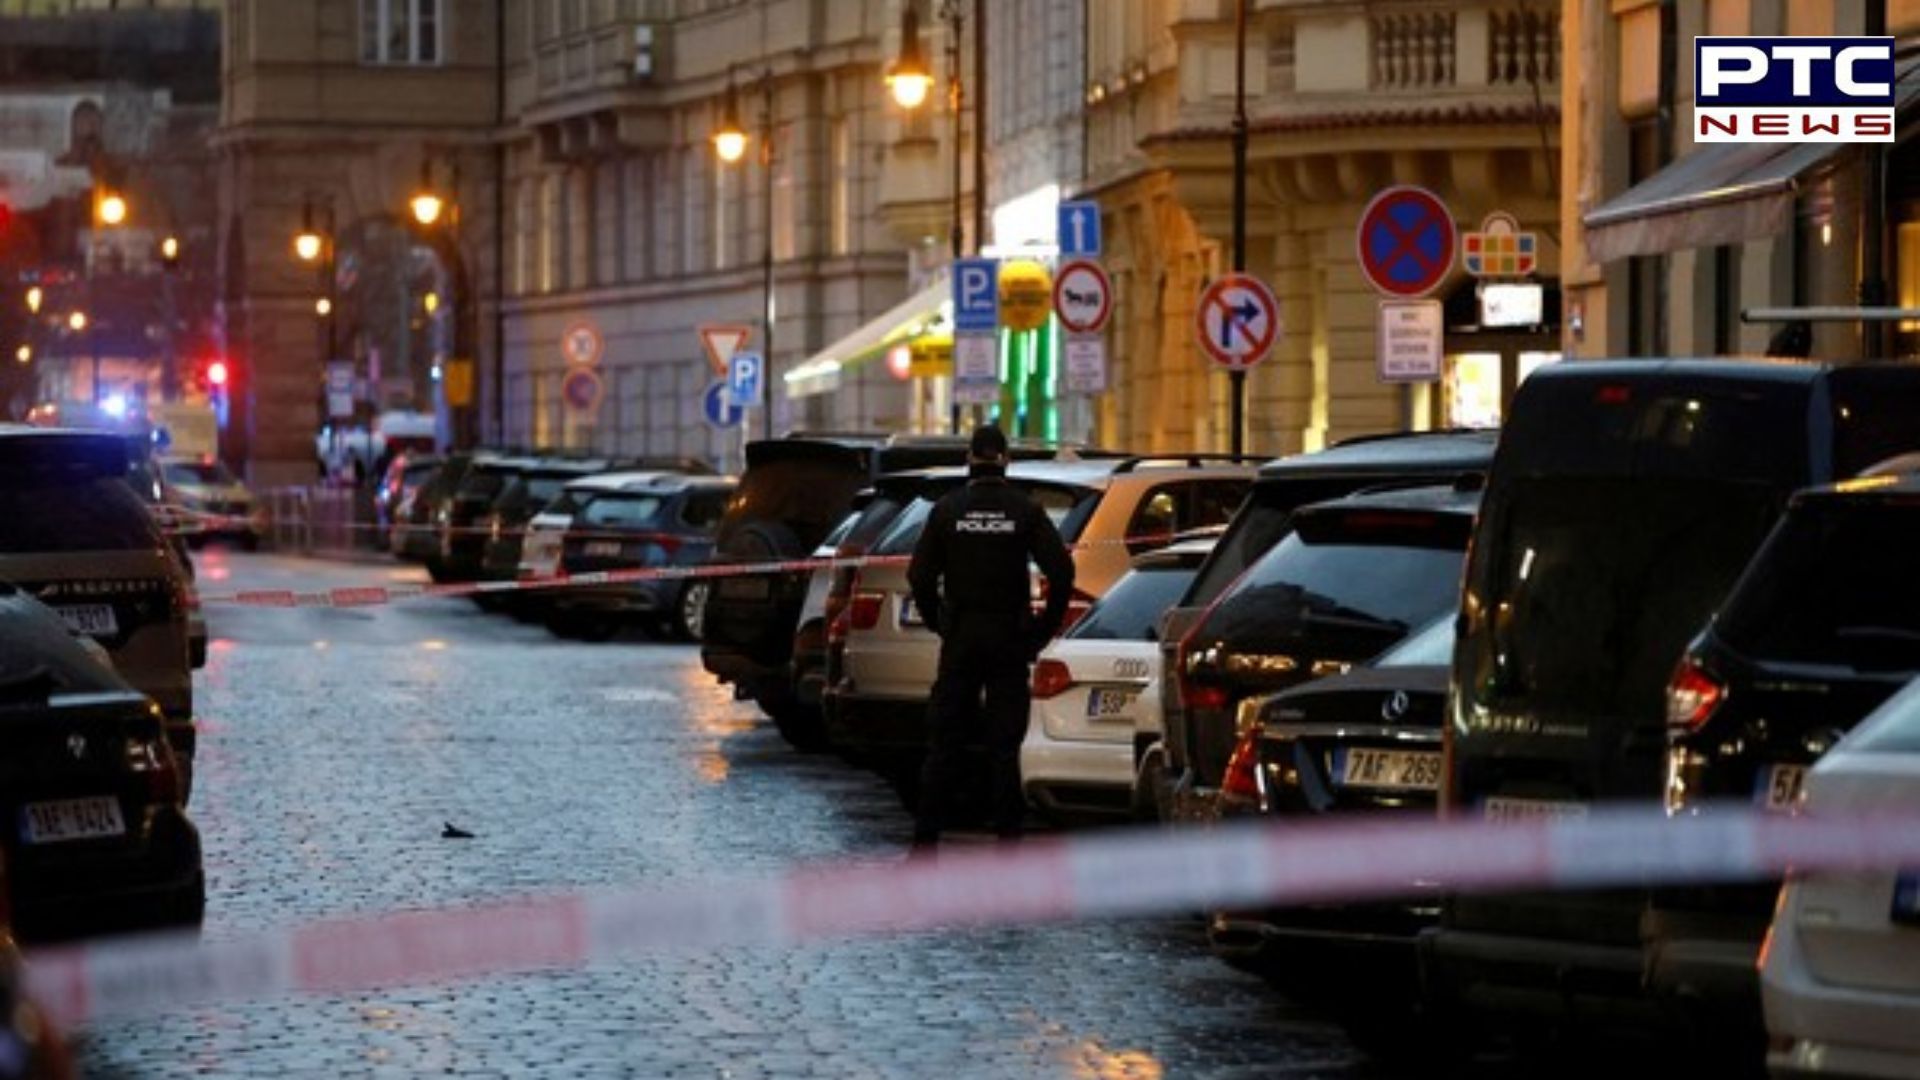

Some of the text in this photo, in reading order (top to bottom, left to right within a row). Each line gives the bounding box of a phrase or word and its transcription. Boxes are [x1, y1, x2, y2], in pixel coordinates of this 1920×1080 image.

[962, 267, 989, 310] P
[735, 359, 755, 388] P
[1348, 750, 1390, 782] 7AF
